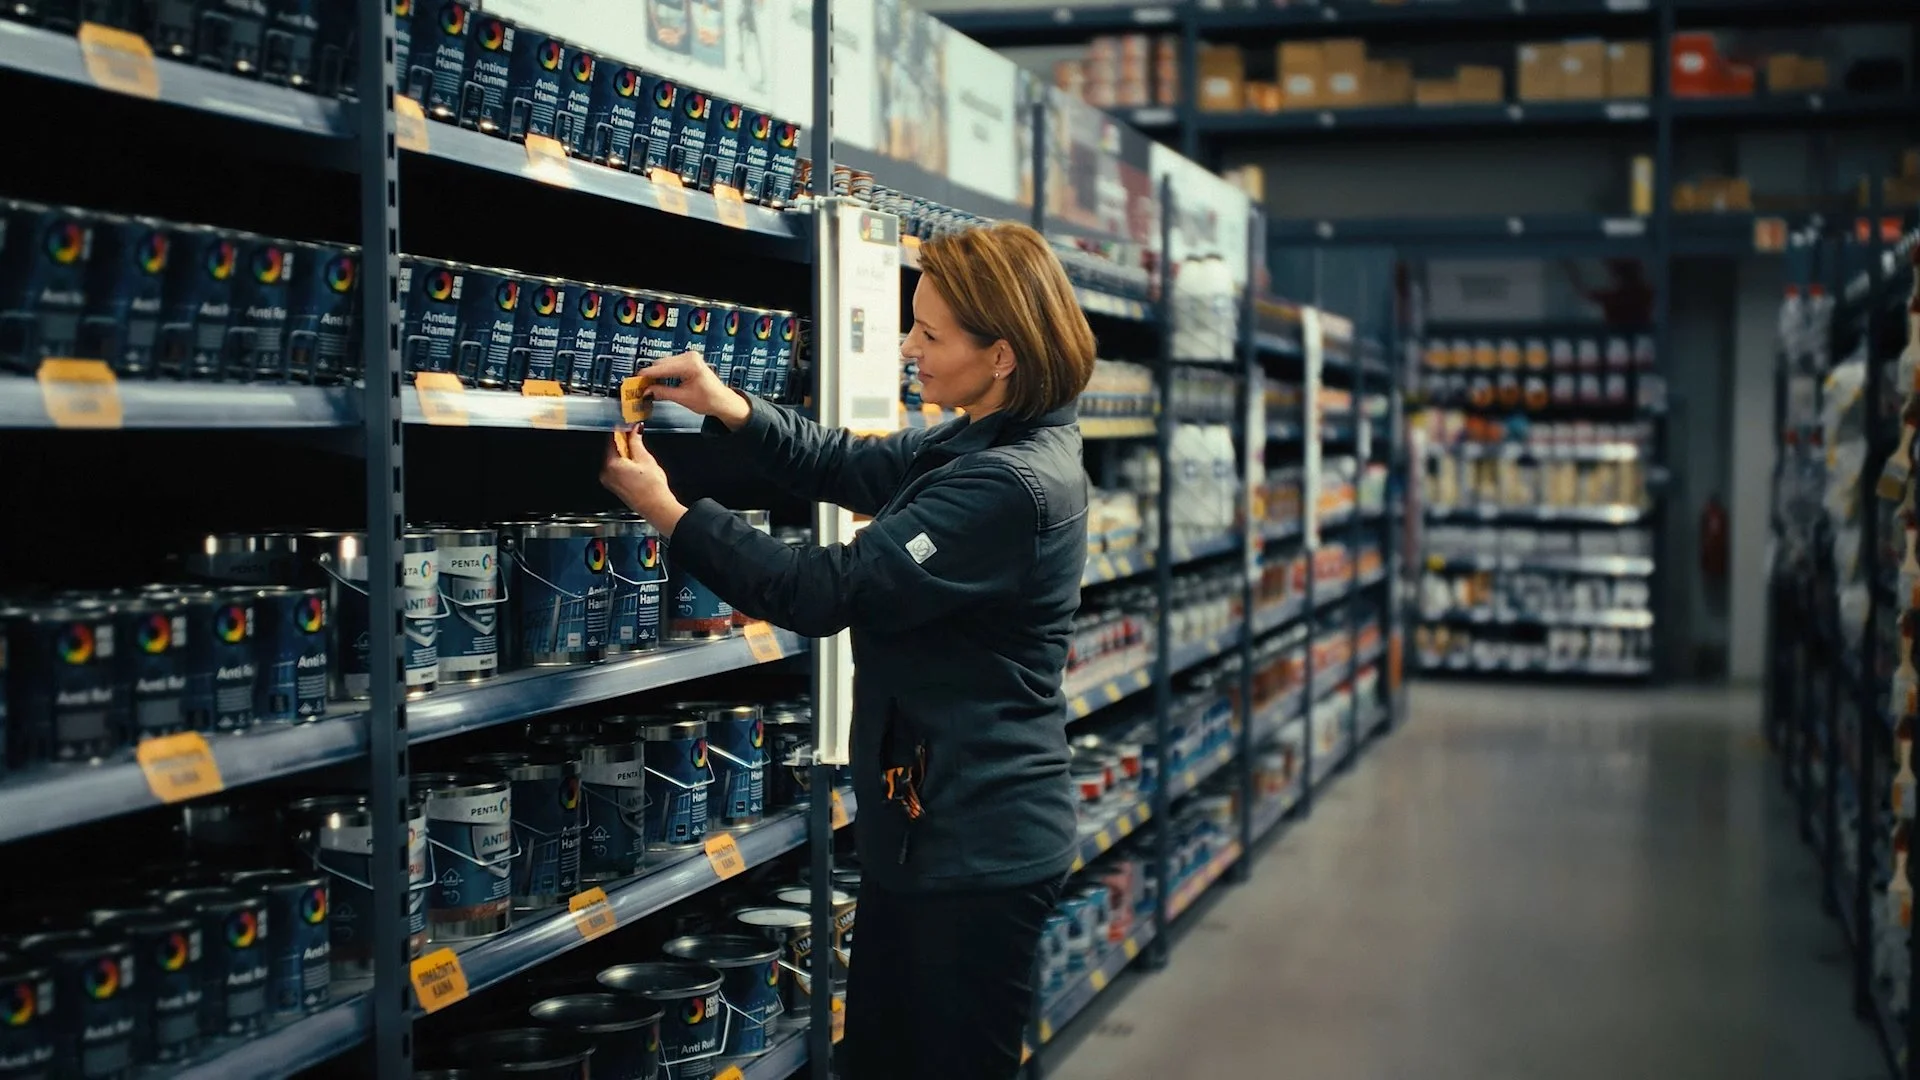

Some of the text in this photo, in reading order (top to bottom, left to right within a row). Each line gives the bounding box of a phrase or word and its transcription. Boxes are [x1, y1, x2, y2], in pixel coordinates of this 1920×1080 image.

[452, 560, 480, 568] PENTA
[471, 808, 498, 817] PENTA
[682, 1043, 701, 1054] Anti
